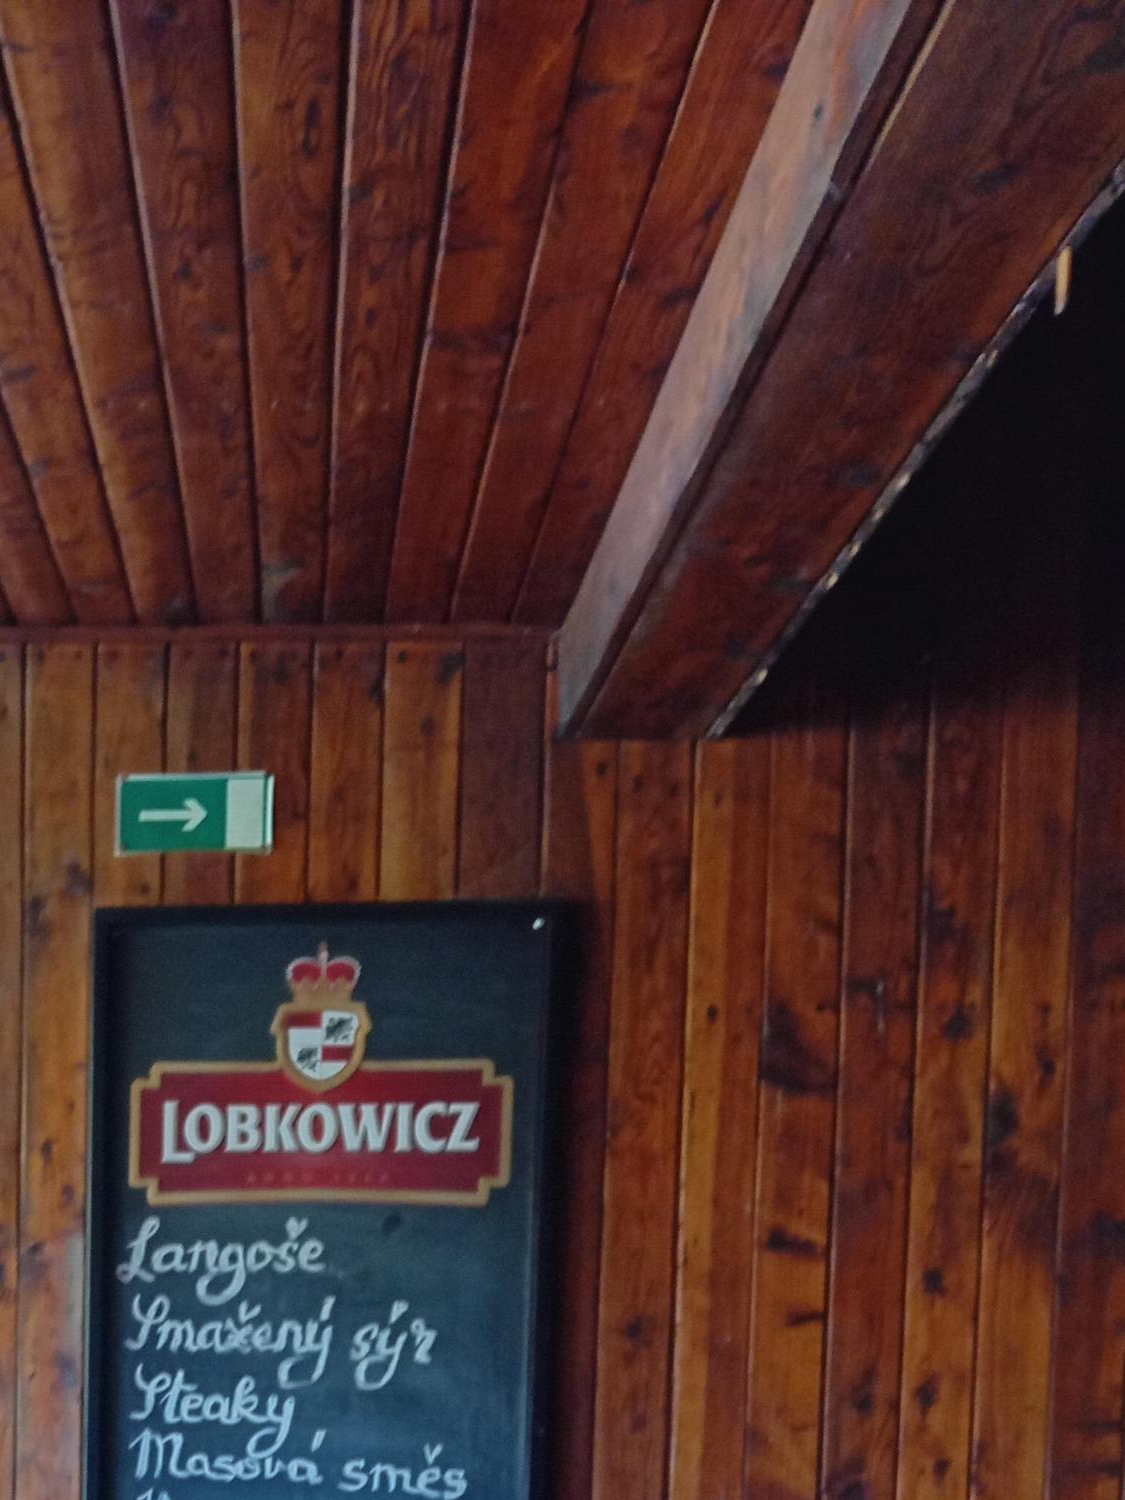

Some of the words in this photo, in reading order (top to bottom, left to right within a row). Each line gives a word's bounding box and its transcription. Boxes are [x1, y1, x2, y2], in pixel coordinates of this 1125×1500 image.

[161, 1100, 481, 1164] LOBKOWICZ
[115, 1216, 326, 1306] Langoše
[124, 1294, 336, 1390] Smažený
[349, 1301, 438, 1391] sýr
[128, 1363, 295, 1458] Steaky
[128, 1427, 327, 1485] Masová
[336, 1443, 469, 1500] směs
